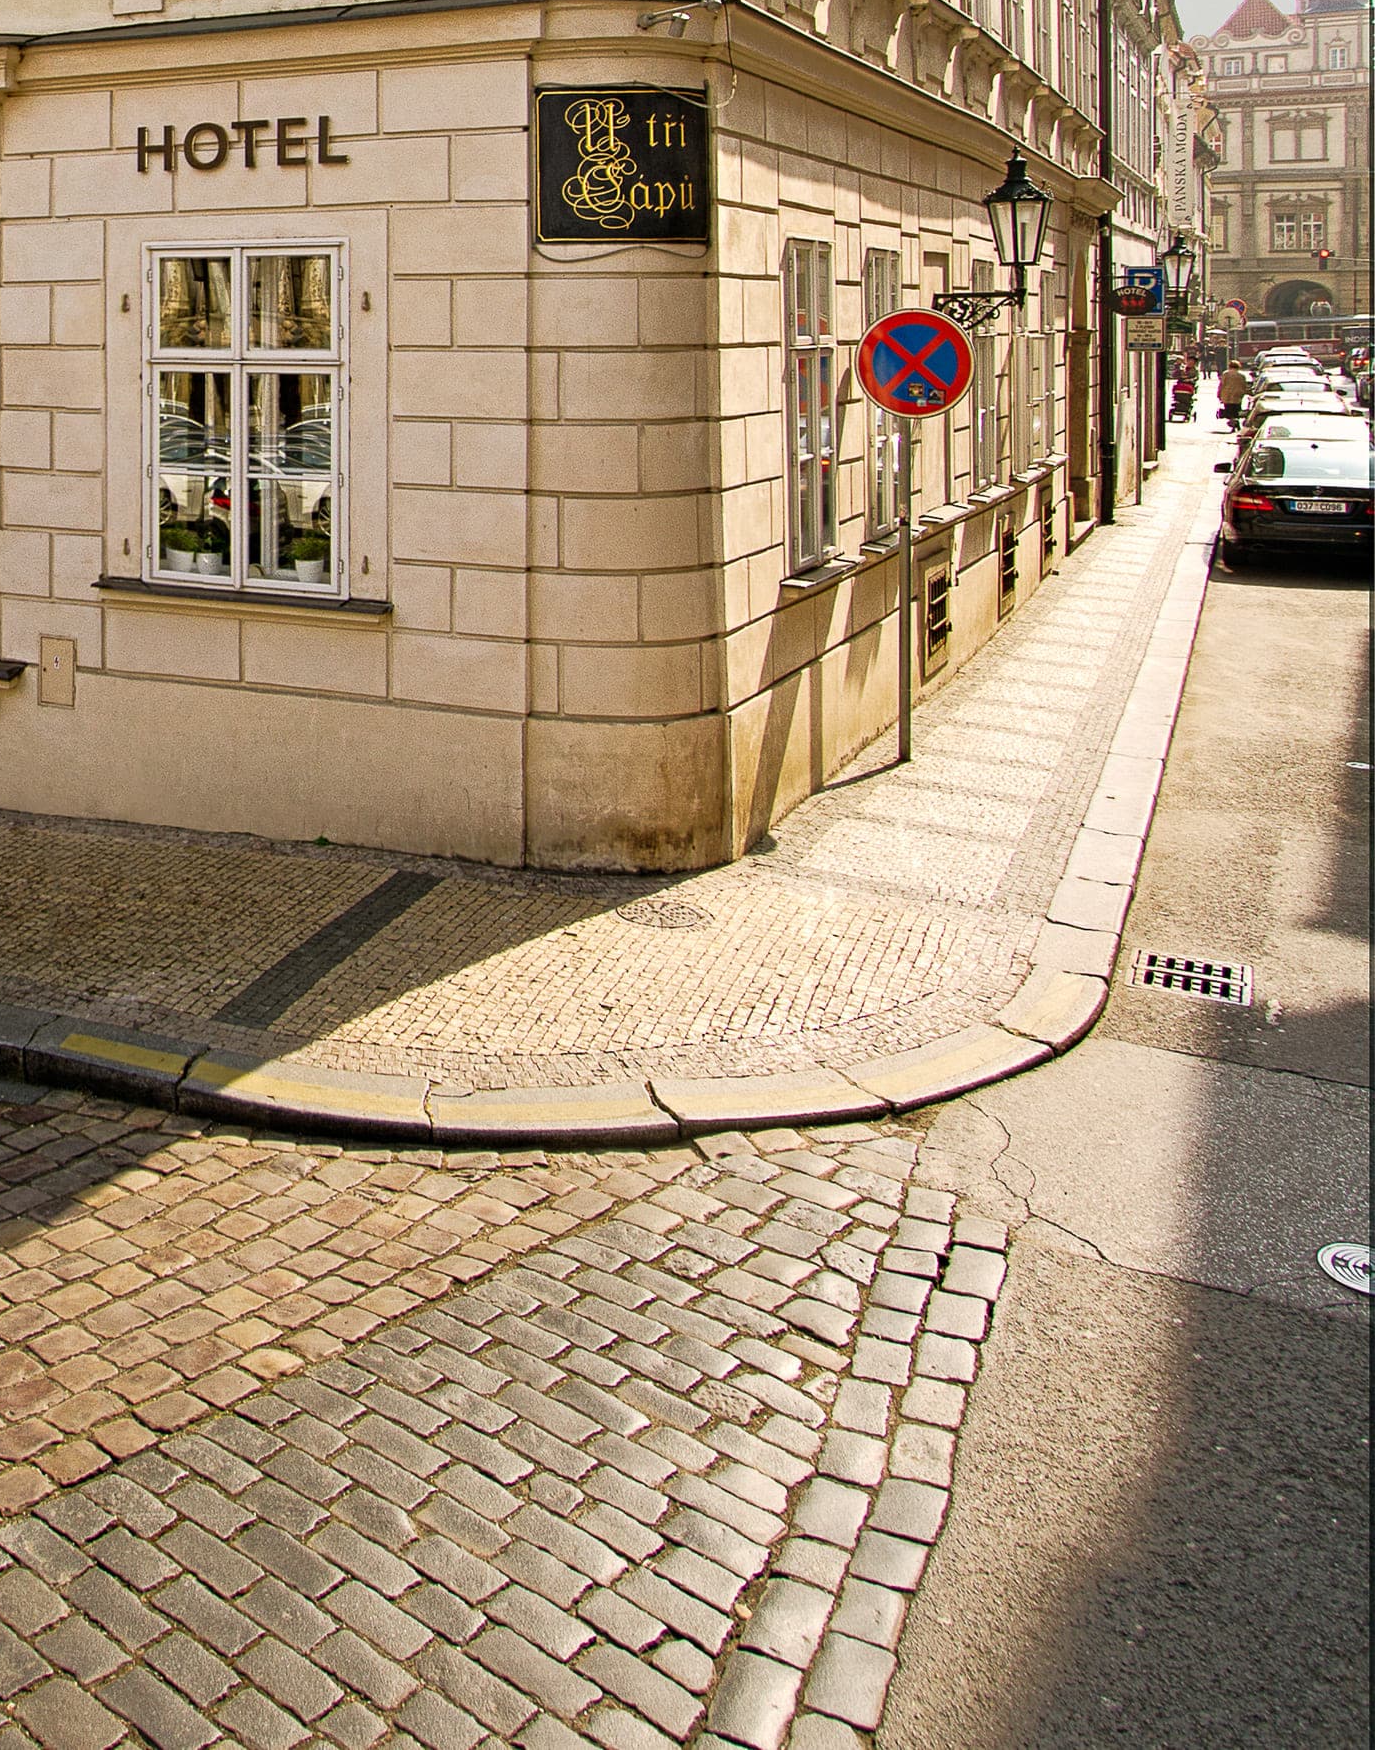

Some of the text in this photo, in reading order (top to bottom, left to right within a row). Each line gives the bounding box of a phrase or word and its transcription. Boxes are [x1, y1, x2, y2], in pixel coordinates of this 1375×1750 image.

[137, 115, 351, 172] HOTEL
[646, 113, 687, 148] tří
[1172, 112, 1187, 212] PÁNSKÁ MÓDA
[1116, 287, 1147, 297] HOTEL
